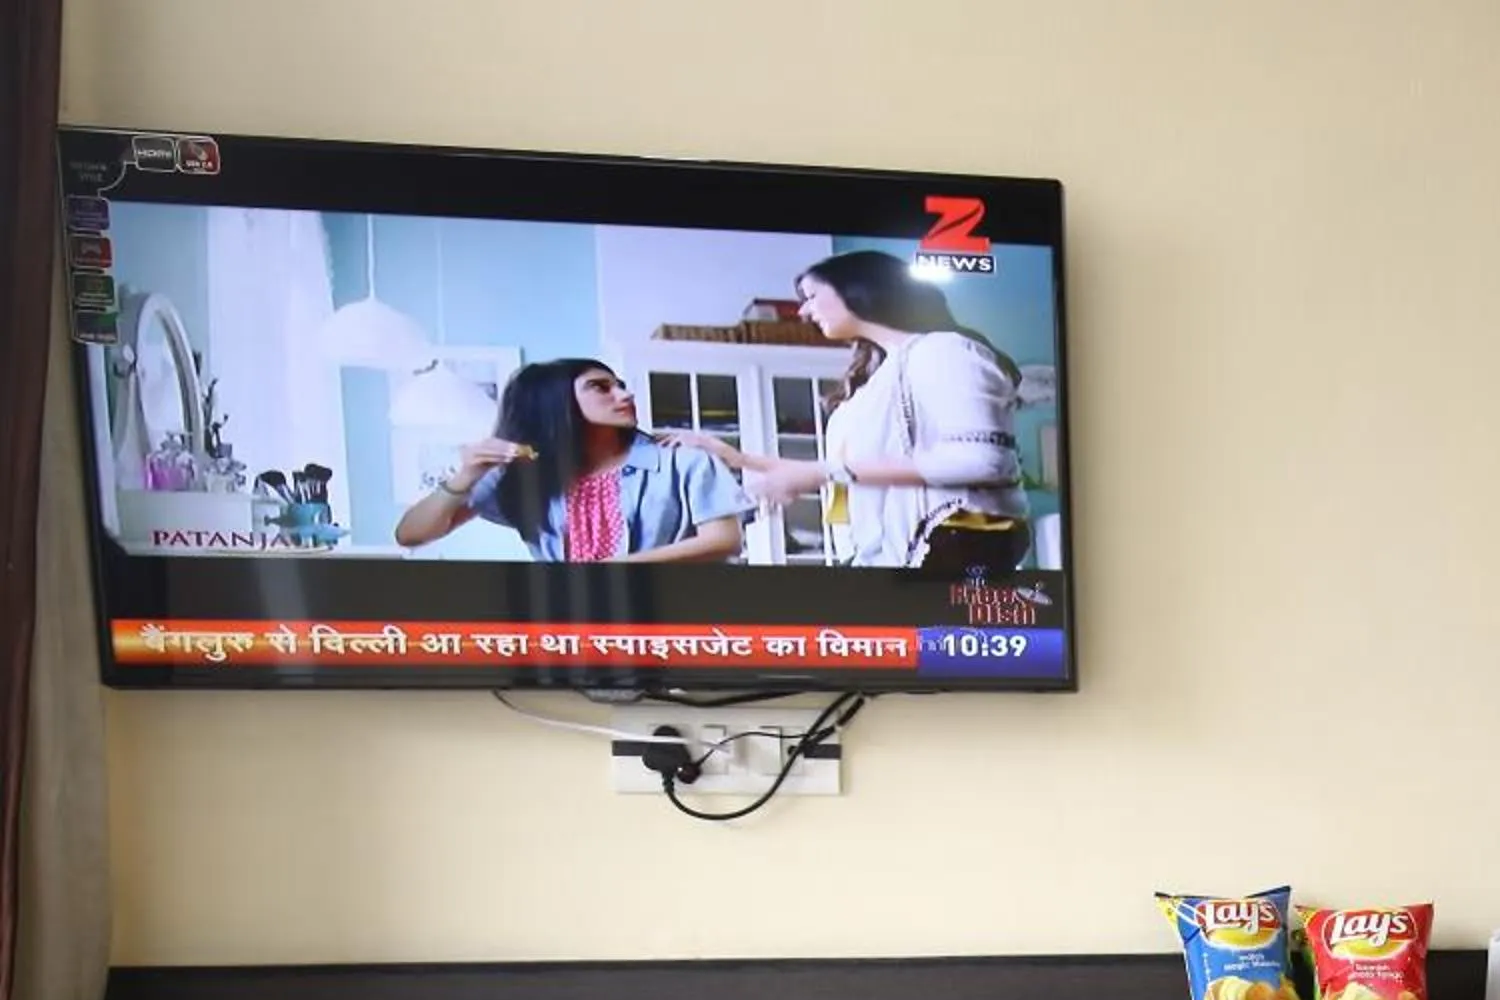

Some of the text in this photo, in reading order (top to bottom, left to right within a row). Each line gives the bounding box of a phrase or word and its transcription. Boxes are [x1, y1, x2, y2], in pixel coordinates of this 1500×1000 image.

[917, 255, 992, 272] NEWS
[152, 530, 312, 550] PATANJA
[264, 624, 298, 655] से
[421, 632, 462, 655] आ
[470, 633, 528, 657] रहा
[540, 633, 580, 656] था
[589, 628, 753, 660] स्पाइसजेट
[761, 635, 807, 657] का
[816, 629, 908, 657] विमान
[943, 633, 1028, 658] 10:39
